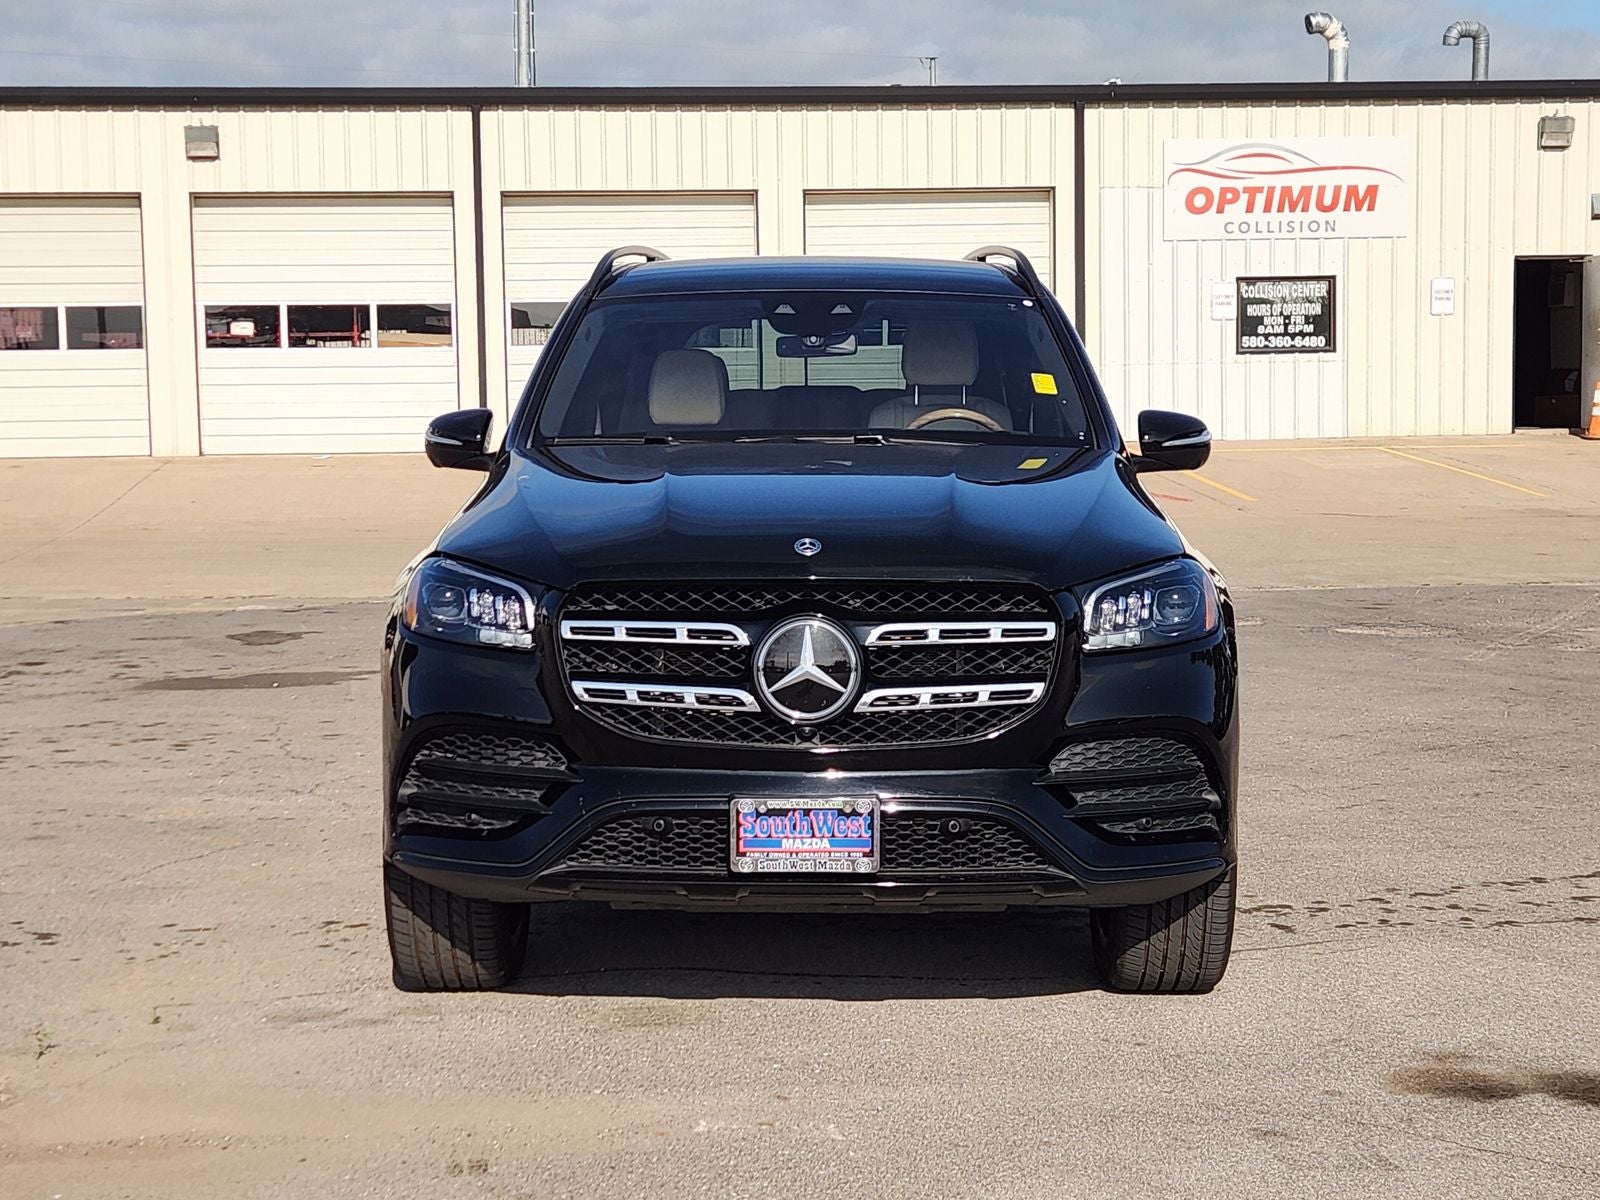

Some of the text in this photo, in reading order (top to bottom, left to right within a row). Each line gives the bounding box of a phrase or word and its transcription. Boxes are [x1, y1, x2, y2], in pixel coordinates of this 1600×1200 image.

[1185, 184, 1379, 215] OPTIMUM
[1223, 220, 1336, 234] COLLISION
[1242, 283, 1327, 298] COLLISION CENTER
[1247, 303, 1322, 316] HOURS OF OPERATION
[1263, 316, 1284, 325] MON
[1290, 315, 1305, 325] FRI
[1241, 336, 1326, 348] 580-360-6480
[781, 838, 831, 849] MAZDA
[758, 859, 852, 871] SouthWest Mazda
